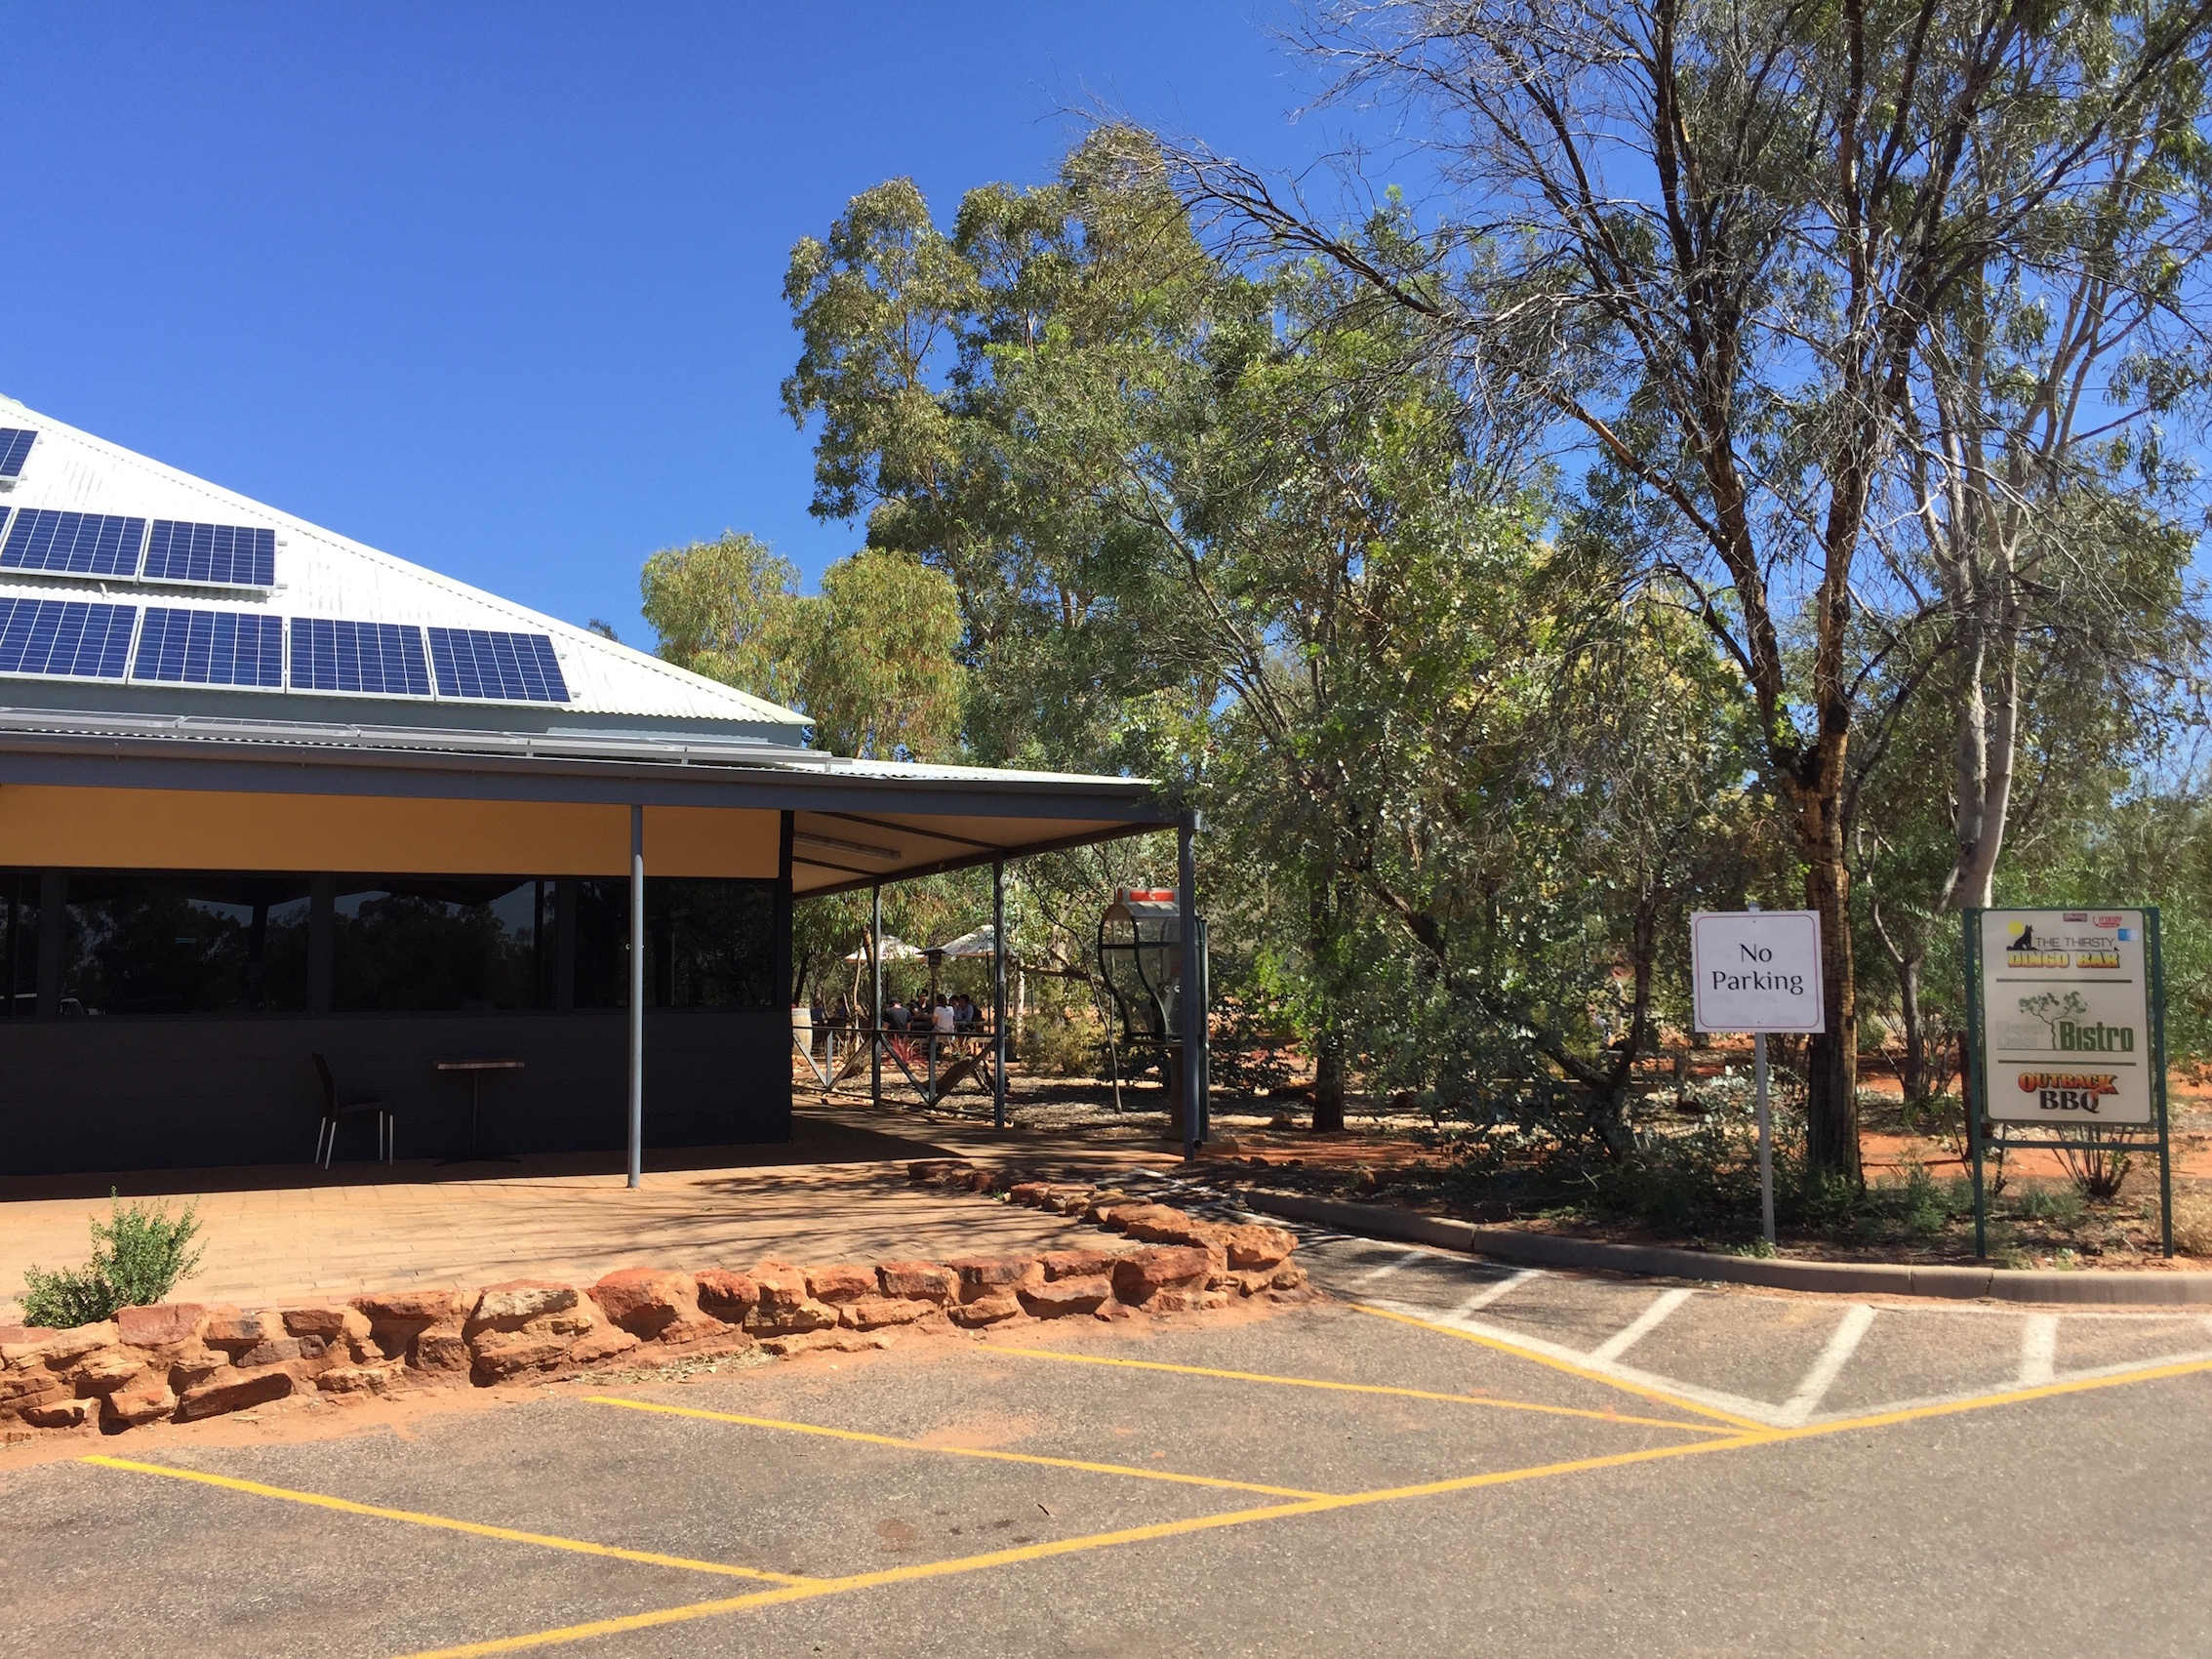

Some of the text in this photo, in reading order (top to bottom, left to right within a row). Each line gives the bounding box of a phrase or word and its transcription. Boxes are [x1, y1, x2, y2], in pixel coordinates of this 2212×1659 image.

[1739, 943, 1773, 963] No
[2035, 937, 2115, 948] THE THIRSTY
[2007, 951, 2120, 969] DINGO BAR
[1711, 971, 1804, 995] Parking
[2059, 1021, 2134, 1052] Bistro
[2018, 1072, 2119, 1095] OUTBACK
[2039, 1090, 2100, 1113] BBQ
